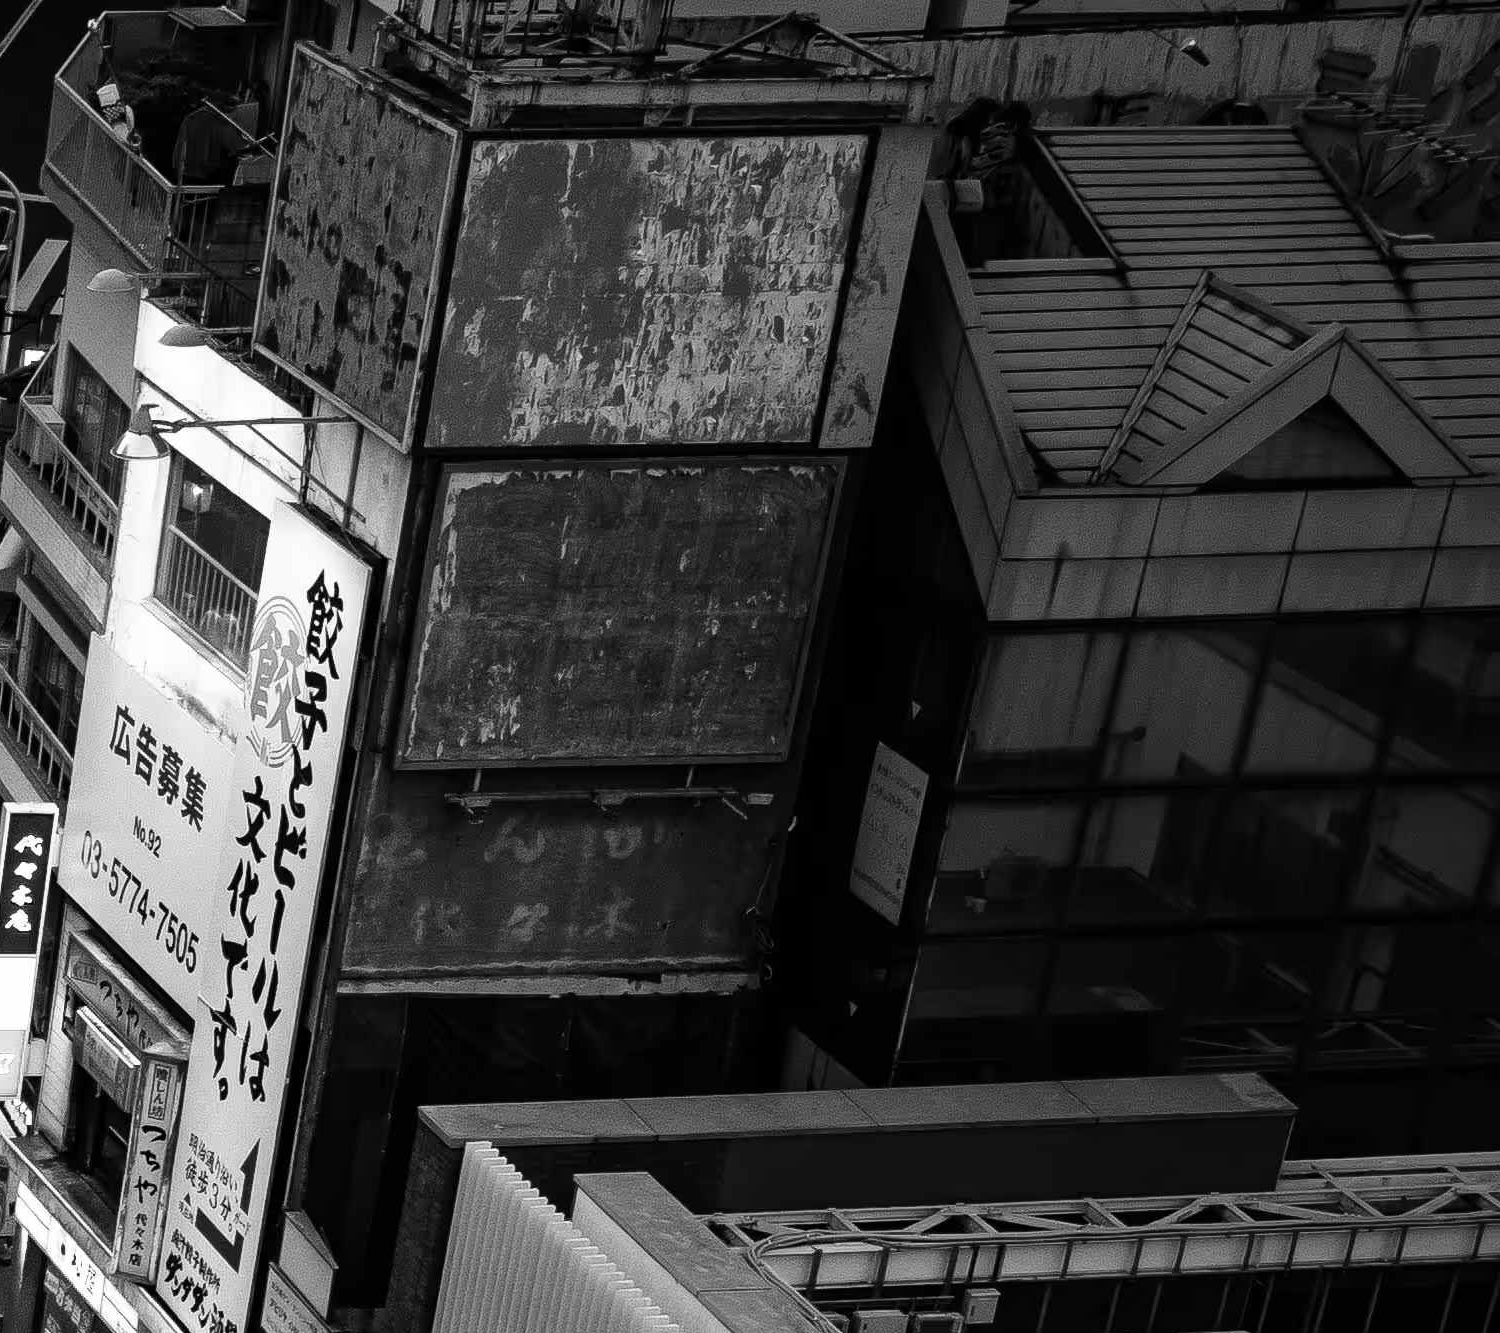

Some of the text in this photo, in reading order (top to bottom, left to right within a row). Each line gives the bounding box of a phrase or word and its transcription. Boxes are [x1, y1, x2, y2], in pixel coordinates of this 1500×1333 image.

[109, 704, 207, 833] 広告募集
[133, 815, 162, 858] No.92
[80, 830, 199, 974] 03-5774-7505
[135, 1125, 168, 1204] つちや
[129, 1212, 149, 1267] 代々木店
